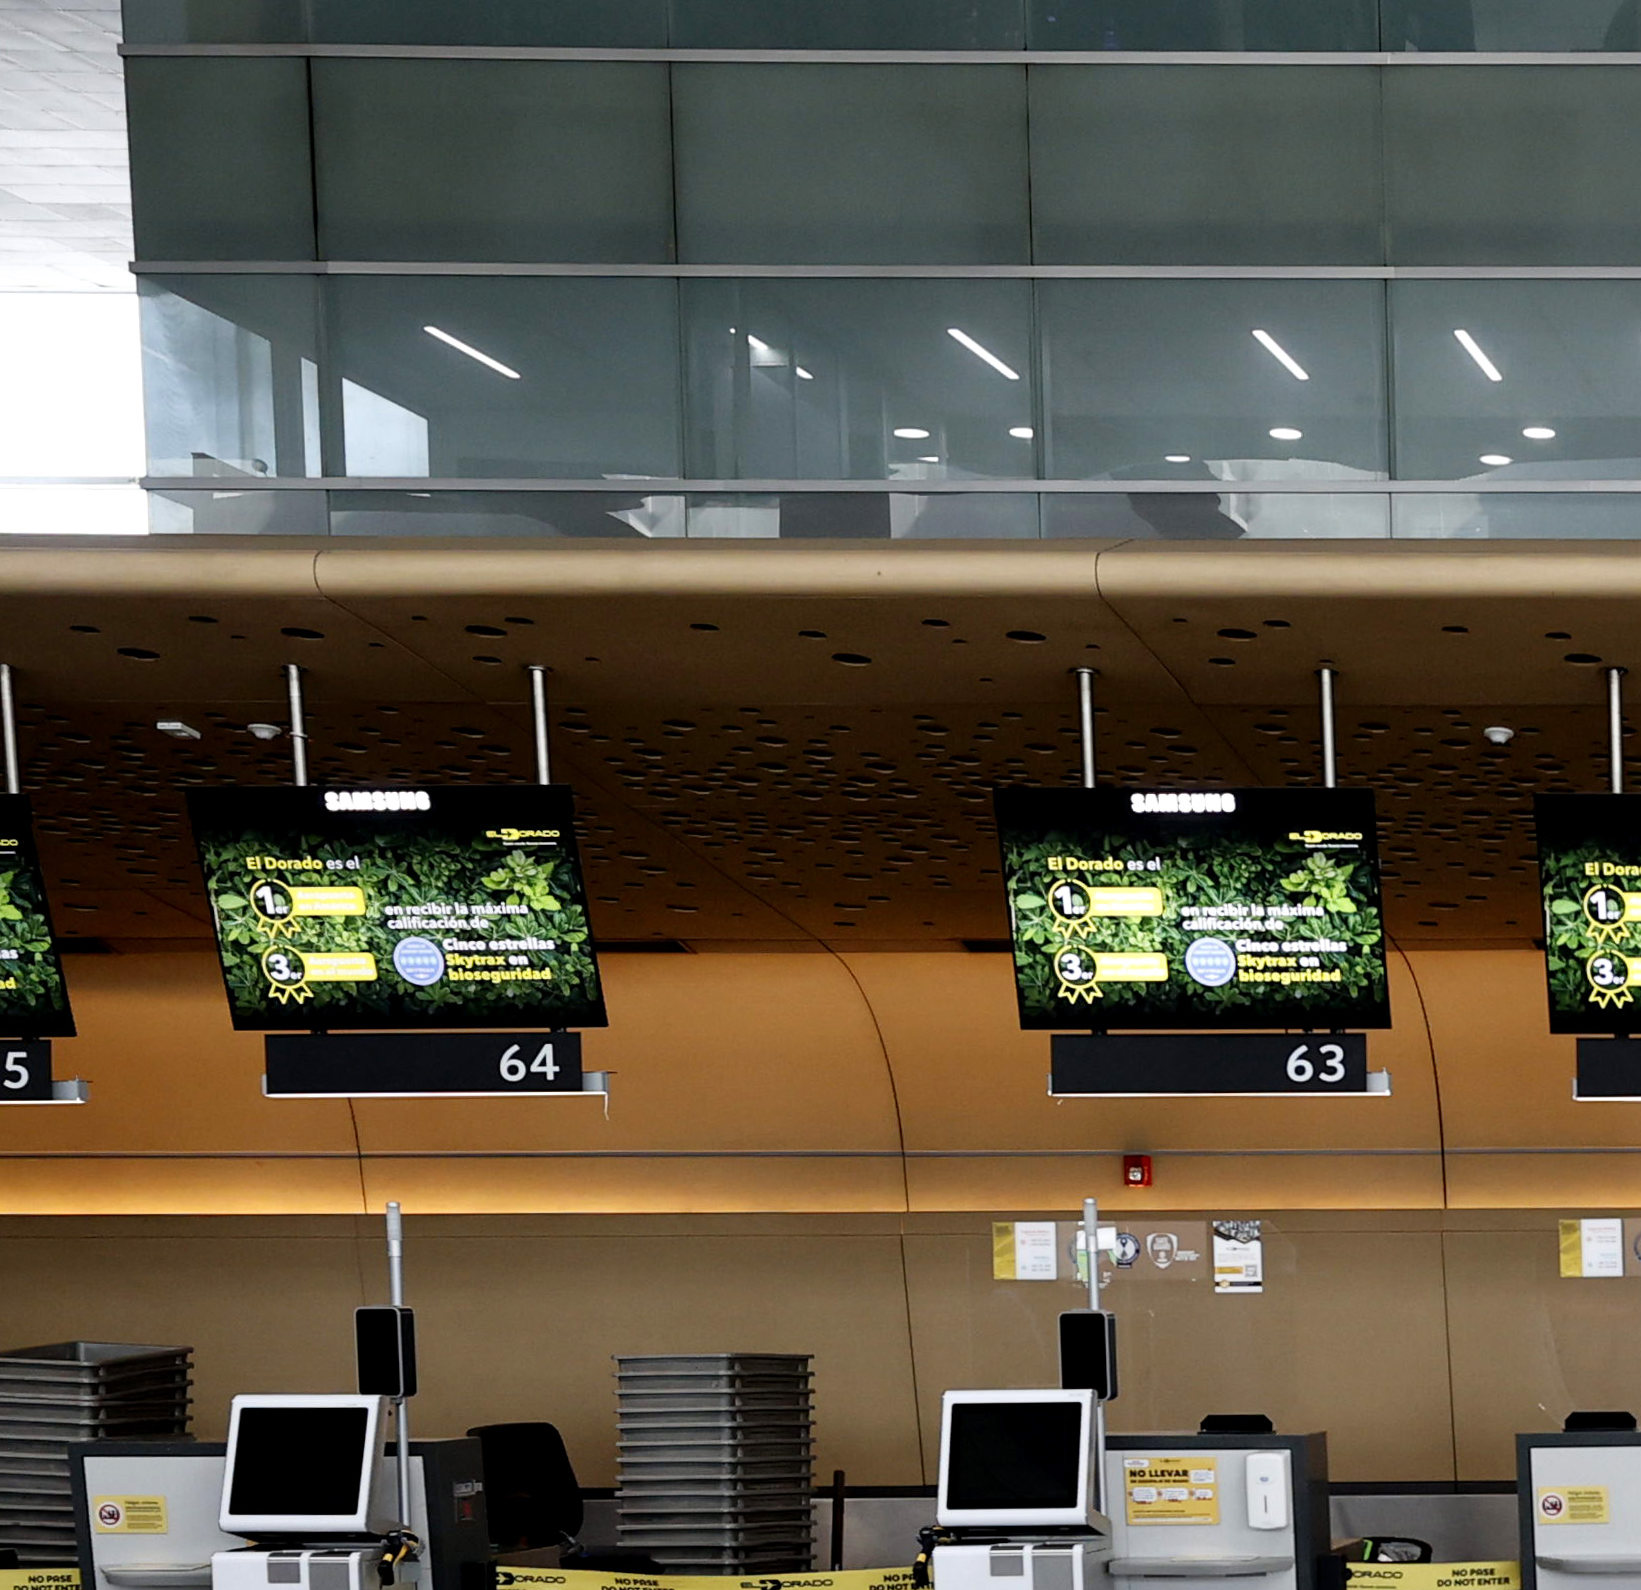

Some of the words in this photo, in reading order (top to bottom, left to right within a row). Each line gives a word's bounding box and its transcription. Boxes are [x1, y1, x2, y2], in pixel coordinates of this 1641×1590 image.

[324, 791, 431, 811] SAMSUNG
[1130, 792, 1236, 813] SAMSUNG
[246, 856, 262, 870] El
[264, 856, 323, 870] Dorado
[326, 859, 344, 870] es
[346, 856, 360, 870] el
[385, 905, 403, 916] en
[406, 902, 452, 916] recibir
[454, 902, 468, 916] la
[470, 902, 529, 916] máxima
[387, 915, 467, 930] calificación
[469, 916, 489, 930] de
[442, 938, 486, 952] Cinco
[489, 938, 556, 952] estrellas
[445, 952, 505, 969] Skytrax
[508, 955, 529, 966] en
[448, 967, 553, 984] bioseguridad
[1238, 968, 1342, 986] bioseguridad
[499, 1044, 560, 1082] 64
[1286, 1044, 1346, 1083] 63
[1129, 1470, 1146, 1478] NO
[1149, 1469, 1189, 1478] LLEVAR
[28, 1575, 44, 1583] NO
[883, 1574, 900, 1582] NO
[1452, 1568, 1468, 1578] NO
[614, 1577, 630, 1587] NO
[1437, 1578, 1453, 1588] DO
[1455, 1578, 1476, 1587] NOT
[1477, 1576, 1510, 1586] ENTER
